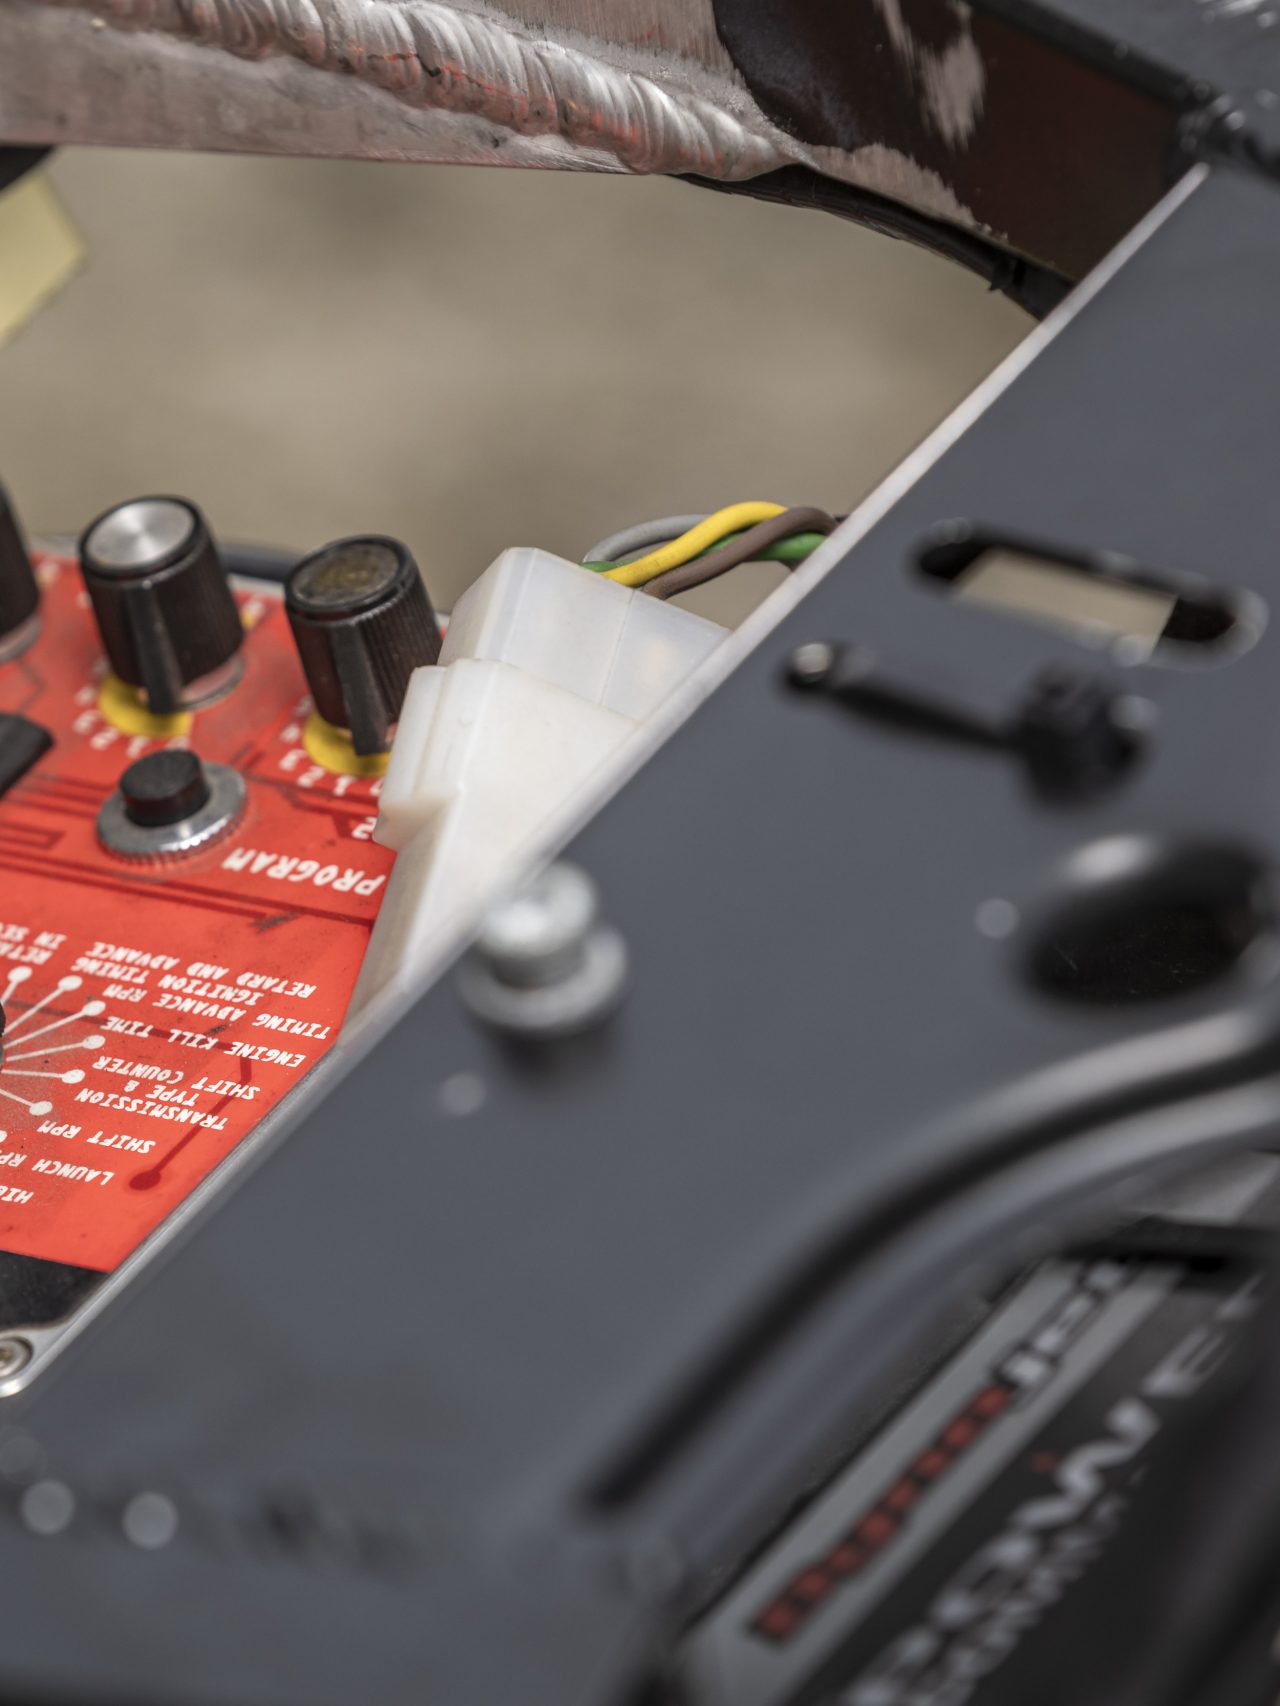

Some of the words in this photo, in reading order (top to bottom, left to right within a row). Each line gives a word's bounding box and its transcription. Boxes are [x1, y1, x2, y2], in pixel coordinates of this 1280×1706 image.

[221, 848, 386, 896] PROGRAM
[71, 955, 151, 984] TIMING
[85, 941, 179, 973] ADVANCE
[186, 960, 229, 982] AND
[235, 971, 317, 998] RETARD
[101, 983, 147, 1003] RPM
[159, 975, 264, 1005] IGNITION
[152, 991, 247, 1024] ADVANCE
[99, 1015, 153, 1039] TIME
[162, 1027, 218, 1050] KILL
[252, 1012, 331, 1040] TIMING
[225, 1041, 306, 1068] ENGINE
[92, 1055, 184, 1084] COUNTER
[147, 1084, 198, 1107] TYPE
[190, 1076, 260, 1100] SHIFT
[74, 1088, 228, 1129] TRANSMISSION
[37, 1121, 80, 1139] RPM
[86, 1131, 156, 1153] SHIFT
[32, 1158, 114, 1185] LAUNCH
